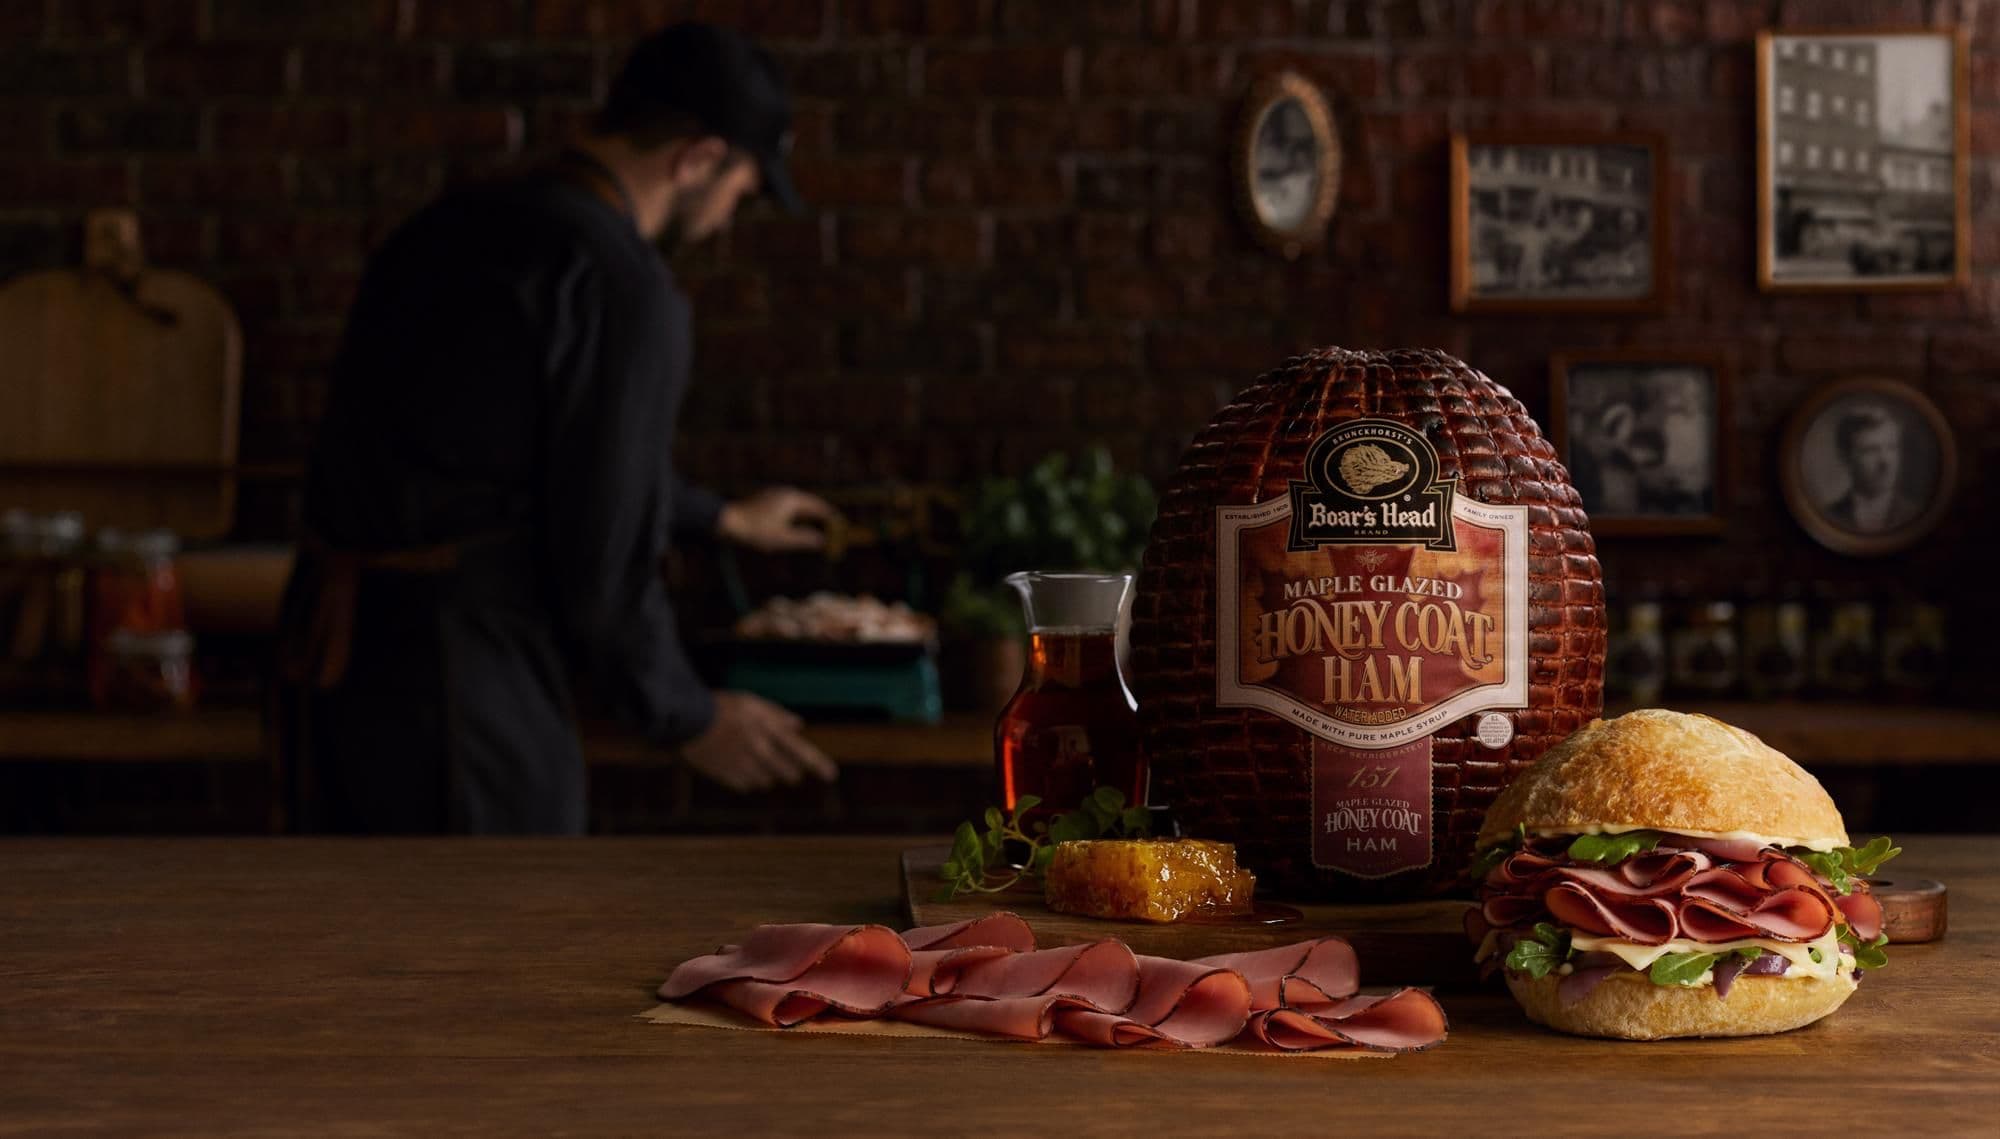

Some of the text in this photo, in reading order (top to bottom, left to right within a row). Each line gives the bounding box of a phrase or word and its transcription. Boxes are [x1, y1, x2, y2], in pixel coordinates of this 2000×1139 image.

[1332, 428, 1412, 445] BRUNCKHORST'S
[1225, 510, 1271, 520] ESTABLISHED
[1308, 501, 1436, 528] Boar's Head
[1463, 506, 1487, 518] FAMILY
[1283, 575, 1463, 600] MAPLE GLAZED
[1256, 598, 1494, 670] HONEY COAT
[1321, 654, 1424, 705] HAM
[1291, 708, 1448, 741] MADE WITH PURE MAPLE SYRUP
[1334, 705, 1407, 723] WATER ADDED
[1347, 764, 1401, 788] 151
[1336, 798, 1410, 809] MAPLE GLAZED
[1324, 807, 1423, 836] HONEY COAT
[1346, 838, 1397, 851] HAM
